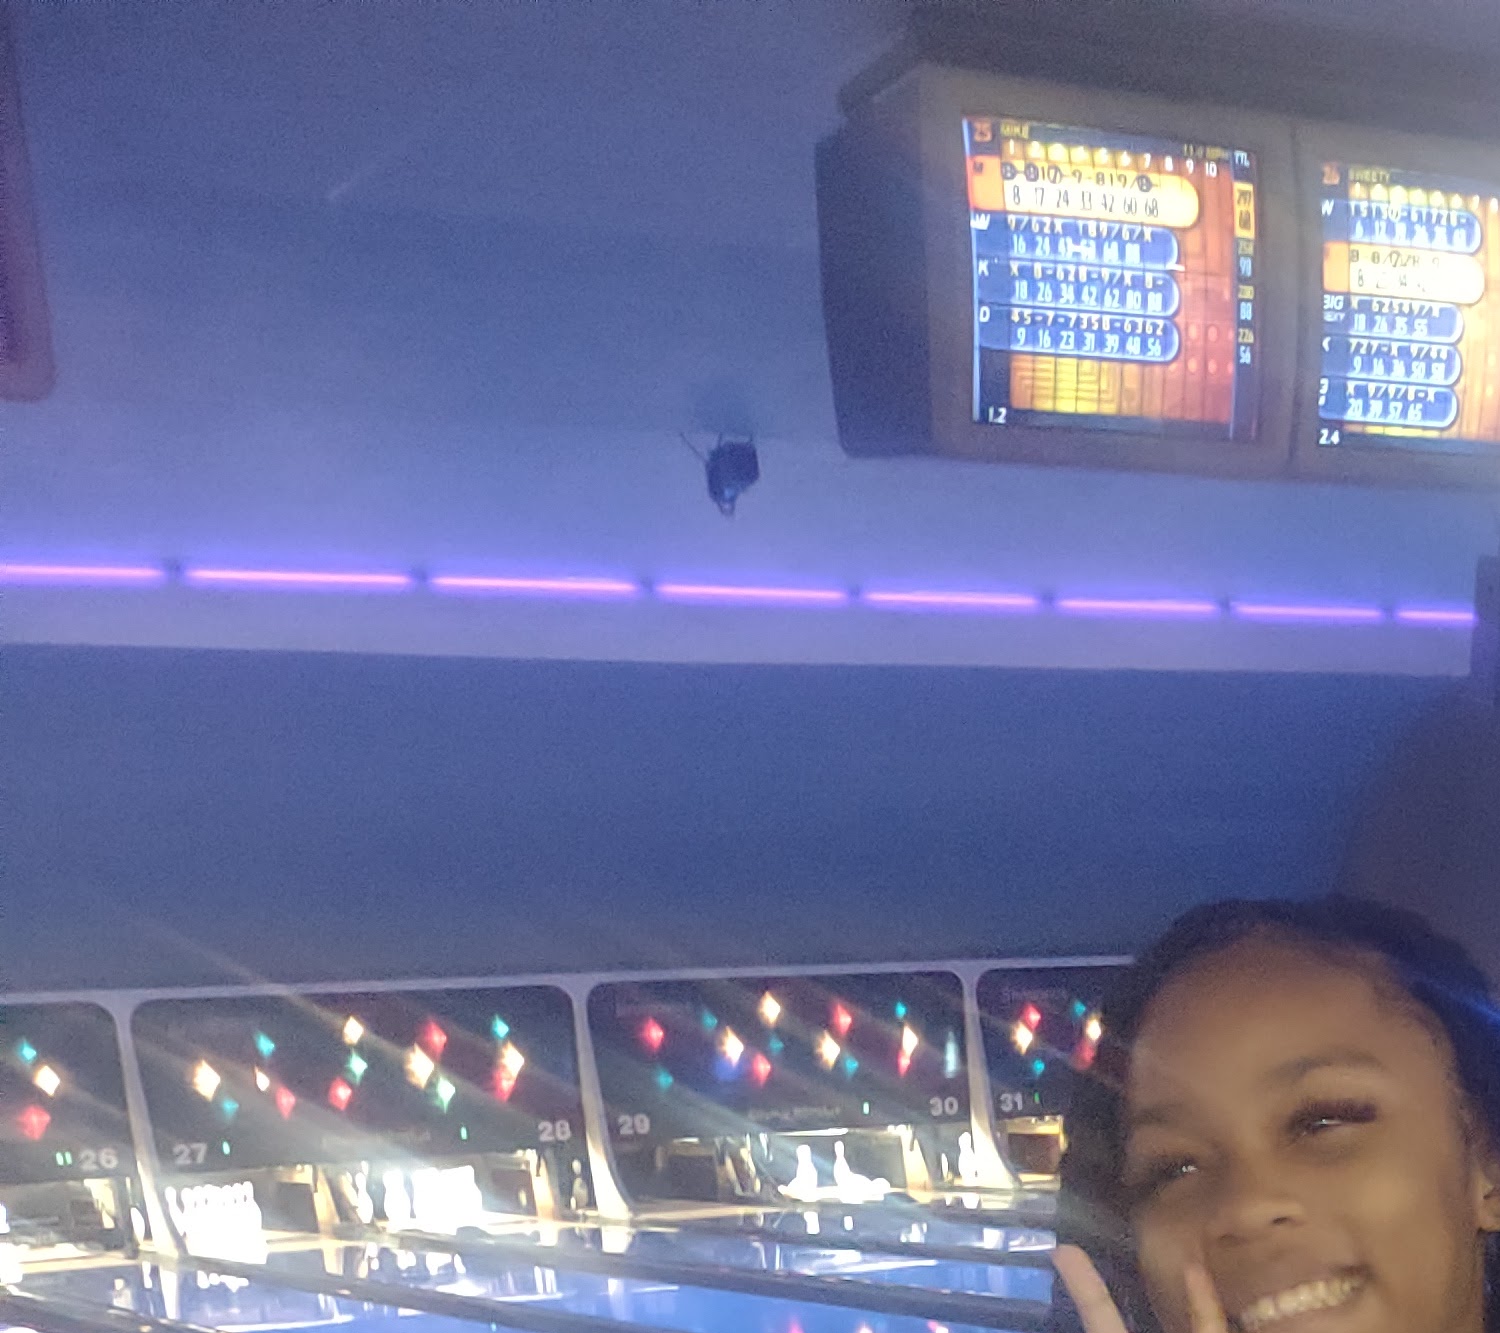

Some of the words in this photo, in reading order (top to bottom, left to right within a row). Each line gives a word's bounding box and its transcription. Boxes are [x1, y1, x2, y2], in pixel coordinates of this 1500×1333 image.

[1143, 153, 1151, 169] 7
[1165, 156, 1173, 171] 8
[1186, 159, 1194, 174] 9
[1205, 161, 1217, 178] 10
[1013, 185, 1020, 206] 8
[1056, 187, 1069, 208] 24
[1102, 192, 1115, 214] 42
[1123, 194, 1138, 216] 60
[1144, 197, 1158, 218] 68
[978, 262, 989, 276] K
[1081, 285, 1097, 305] 42
[1103, 288, 1120, 308] 62
[979, 306, 990, 323] D
[1017, 329, 1026, 346] 9
[1038, 329, 1050, 348] 16
[1059, 331, 1074, 350] 23
[1083, 332, 1095, 352] 31
[1103, 334, 1119, 353] 39
[1147, 337, 1162, 357] 56
[928, 1096, 959, 1116] 30
[999, 1092, 1024, 1111] 31
[537, 1120, 571, 1142] 28
[618, 1112, 651, 1135] 29
[78, 1147, 118, 1170] 26
[172, 1142, 207, 1164] 27
